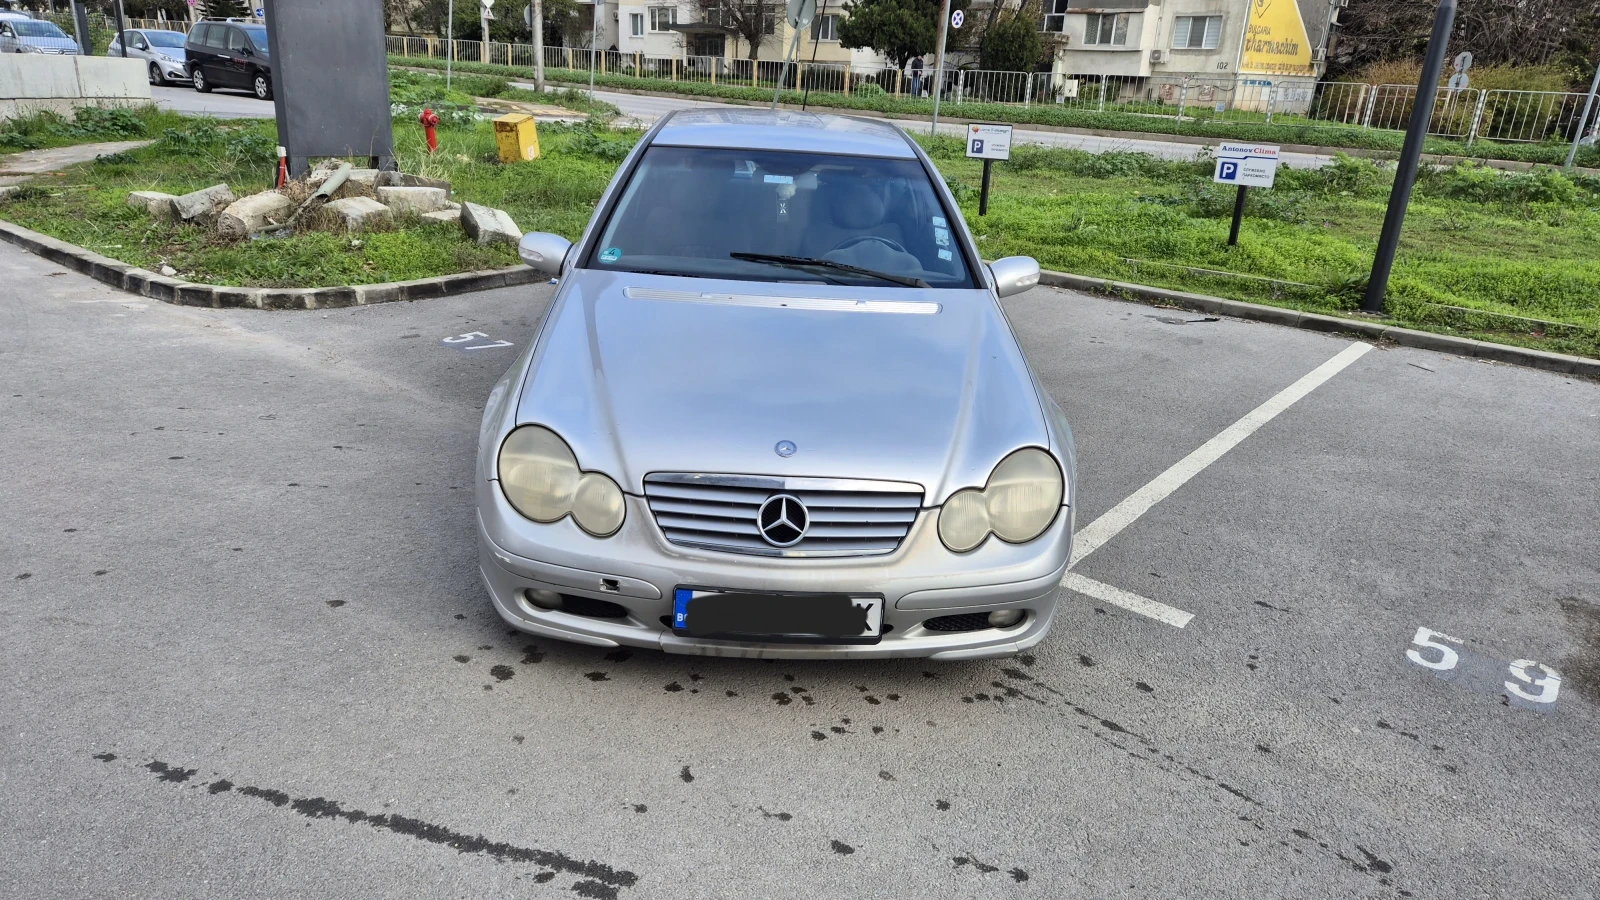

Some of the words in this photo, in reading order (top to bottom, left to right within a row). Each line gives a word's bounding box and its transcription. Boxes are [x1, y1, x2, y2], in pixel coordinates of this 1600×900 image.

[1216, 61, 1229, 70] 102
[974, 141, 981, 151] P
[1222, 145, 1253, 153] Antonov
[1222, 164, 1234, 177] P
